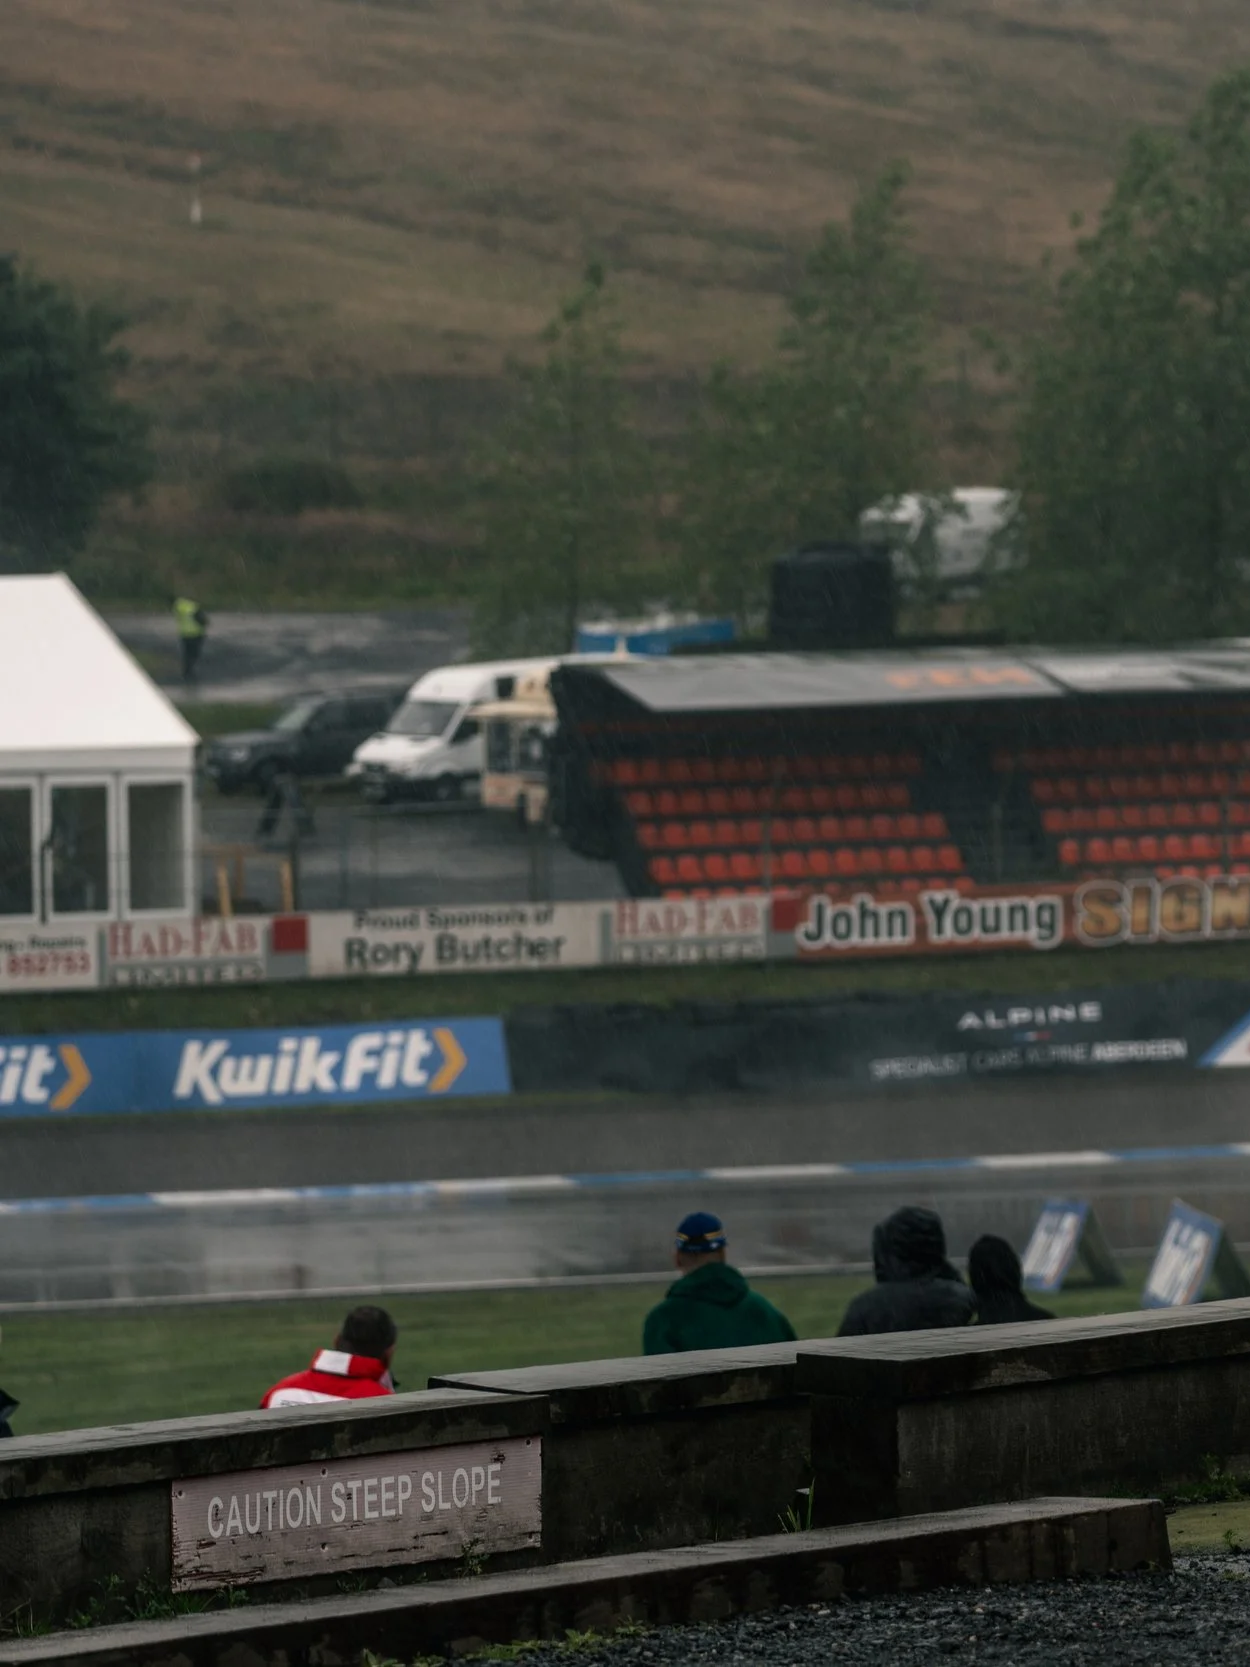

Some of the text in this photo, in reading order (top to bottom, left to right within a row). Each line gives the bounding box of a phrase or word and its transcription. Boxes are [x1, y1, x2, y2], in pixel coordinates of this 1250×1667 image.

[354, 900, 555, 931] Proud Sponsors of
[799, 897, 911, 946] John
[923, 894, 1061, 946] Young
[344, 926, 565, 978] Rory Butcher
[957, 1001, 1102, 1031] ALPINE
[207, 1463, 502, 1539] CAUTION STEEP SLOPE
